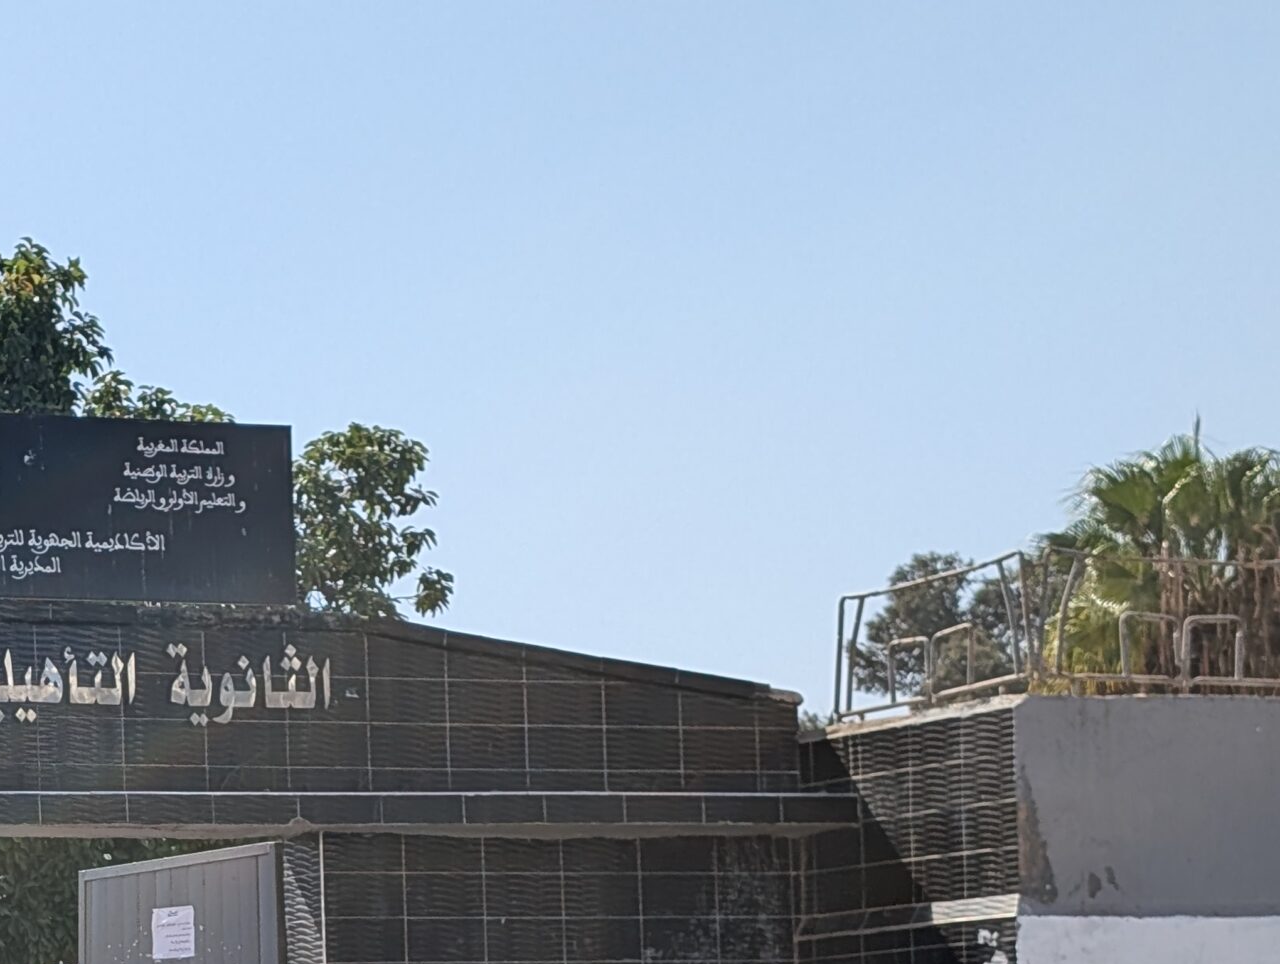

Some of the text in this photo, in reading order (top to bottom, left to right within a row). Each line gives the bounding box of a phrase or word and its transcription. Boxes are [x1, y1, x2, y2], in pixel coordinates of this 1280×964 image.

[136, 436, 225, 458] المملكة المغربية
[169, 464, 203, 485] التربية
[28, 529, 81, 554] الجهوية
[84, 531, 166, 552] الأكاديمية
[10, 555, 62, 579] المديرية
[166, 643, 331, 727] الثانوية
